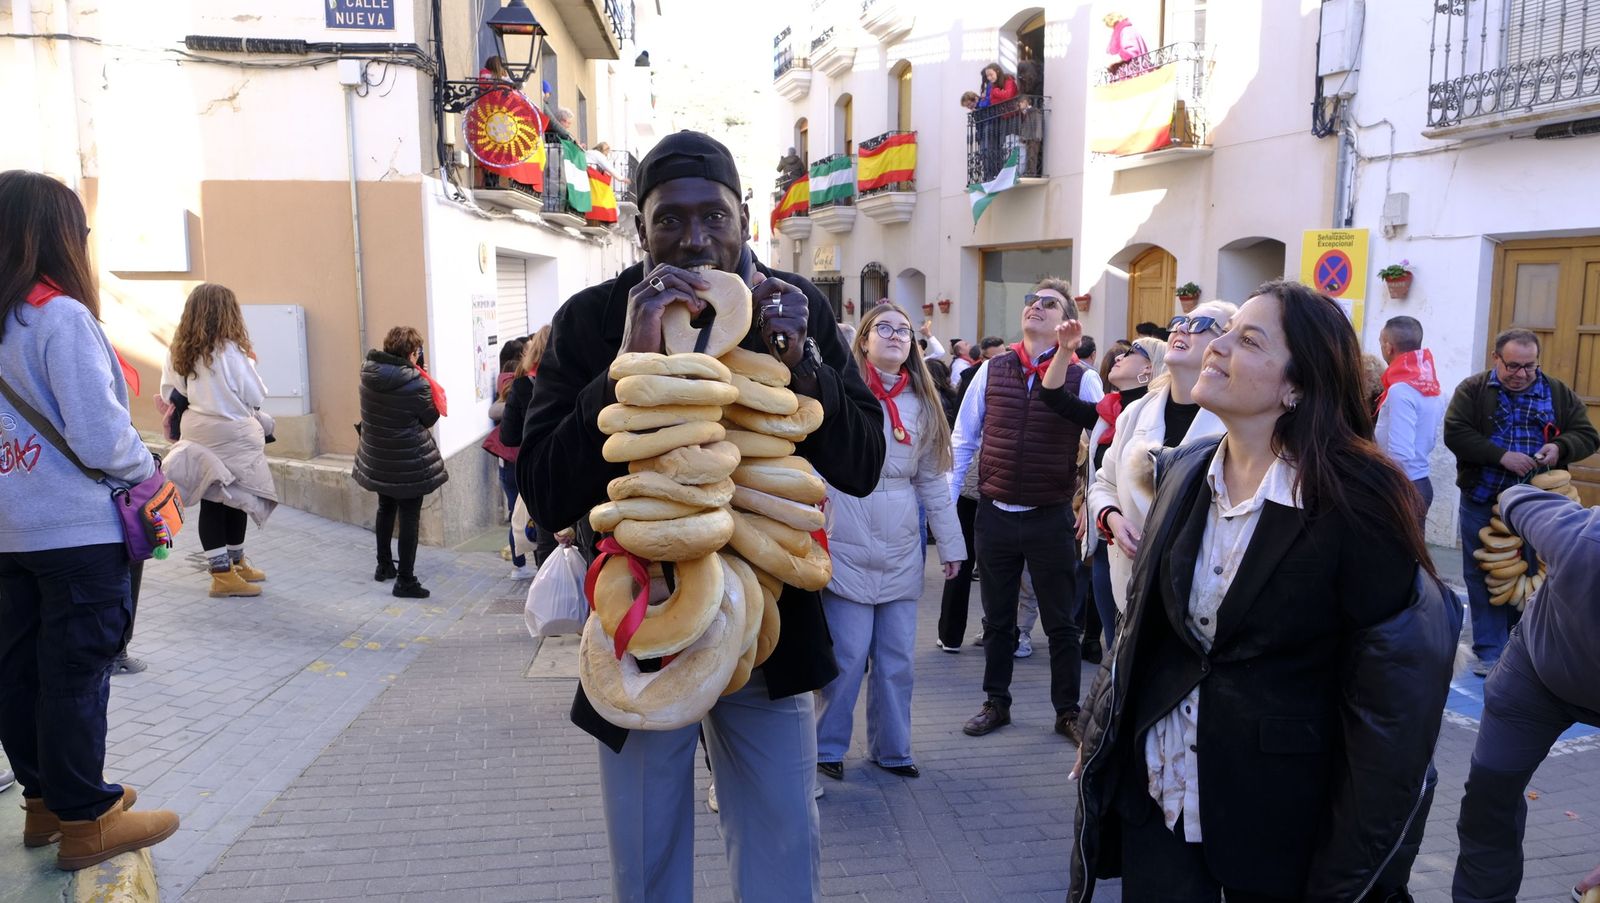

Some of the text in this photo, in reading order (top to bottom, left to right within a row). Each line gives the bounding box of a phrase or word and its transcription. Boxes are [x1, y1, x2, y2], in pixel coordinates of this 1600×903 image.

[346, 0, 389, 9] CALLE
[335, 12, 385, 26] NUEVA
[1317, 240, 1354, 248] Excepcional
